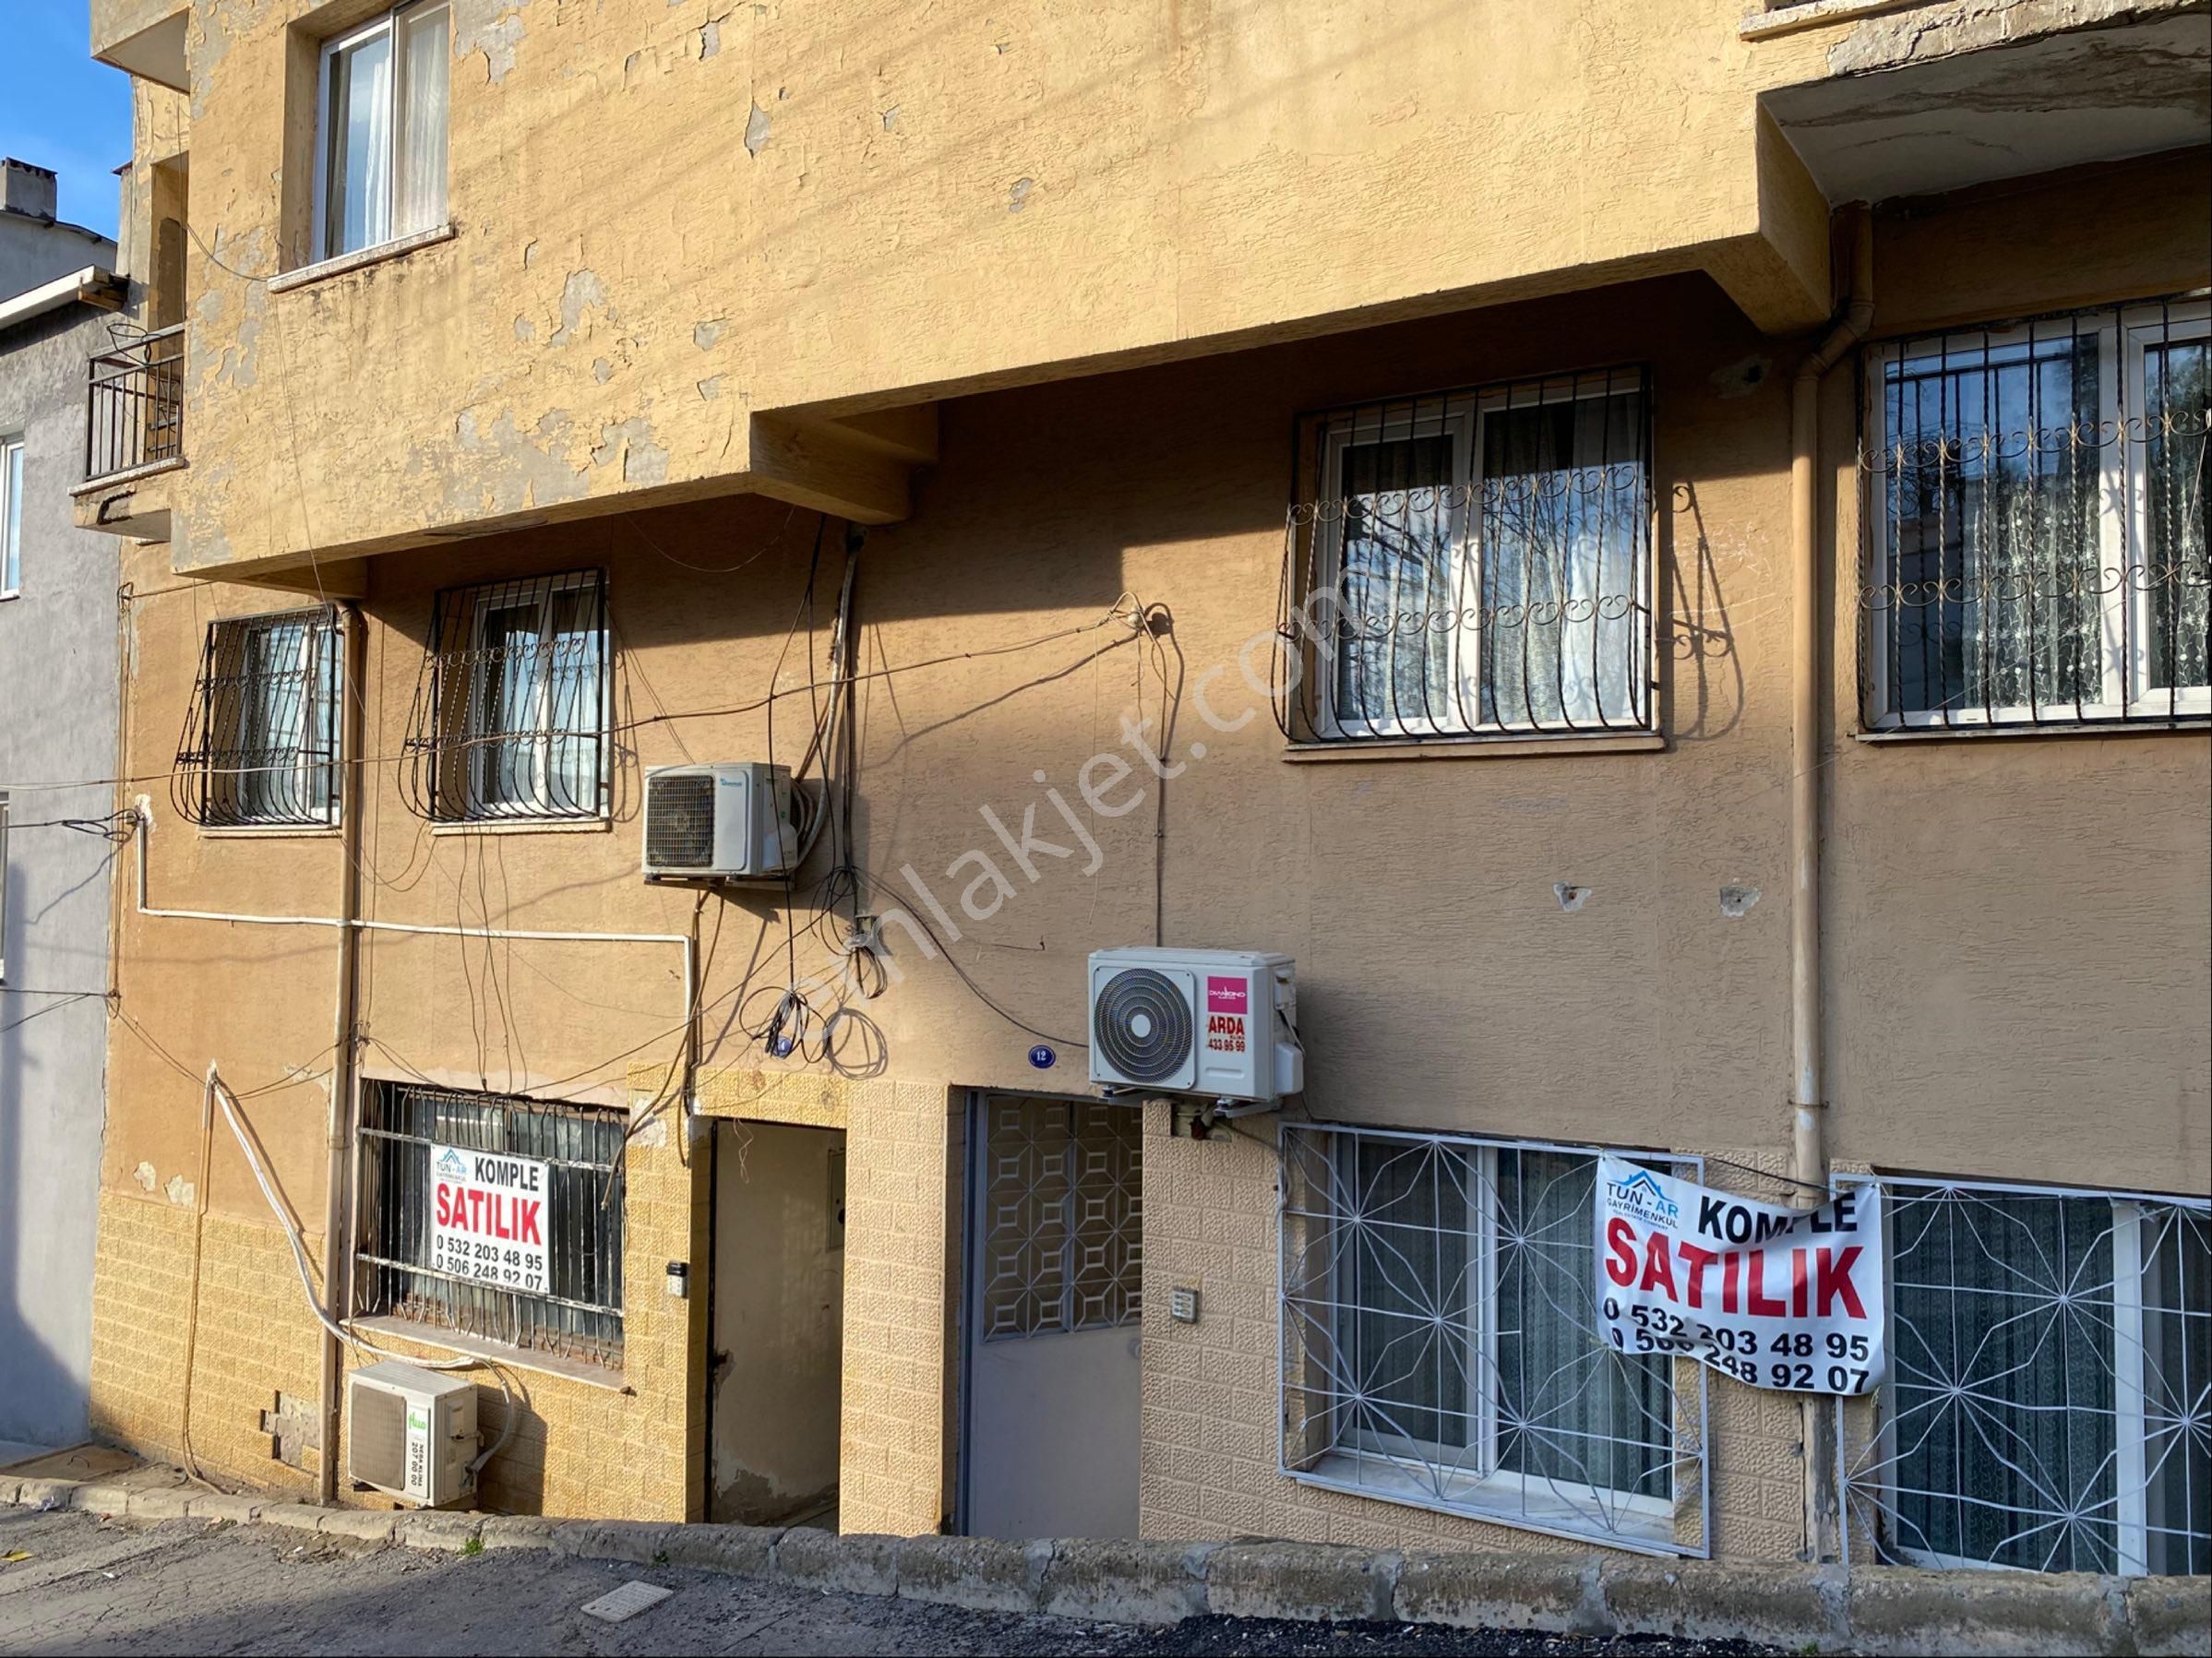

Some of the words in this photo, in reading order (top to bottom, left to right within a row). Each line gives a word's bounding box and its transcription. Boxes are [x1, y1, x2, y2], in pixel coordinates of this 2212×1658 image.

[1208, 1016, 1245, 1034] ARDA
[1036, 1050, 1046, 1061] 12
[1208, 1038, 1223, 1051] 433
[475, 1156, 539, 1192] KOMPLE
[436, 1182, 542, 1246] SATILIK
[1607, 1198, 1678, 1229] GAYRİMENKUL
[436, 1235, 444, 1250] 0
[448, 1237, 471, 1257] 532
[474, 1243, 499, 1262] 203
[503, 1249, 520, 1267] 48
[525, 1253, 543, 1270] 95
[1605, 1216, 1867, 1319] SATILIK
[436, 1254, 444, 1269] 0
[448, 1257, 470, 1275] 506
[473, 1262, 498, 1281] 248
[503, 1269, 520, 1285] 92
[525, 1274, 543, 1291] 07
[1603, 1296, 1620, 1320] 0
[1631, 1304, 1688, 1338] 532
[1770, 1332, 1813, 1357] 48
[1825, 1332, 1869, 1362] 95
[1704, 1343, 1758, 1384] 248
[1771, 1364, 1814, 1390] 92
[1827, 1366, 1870, 1394] 07
